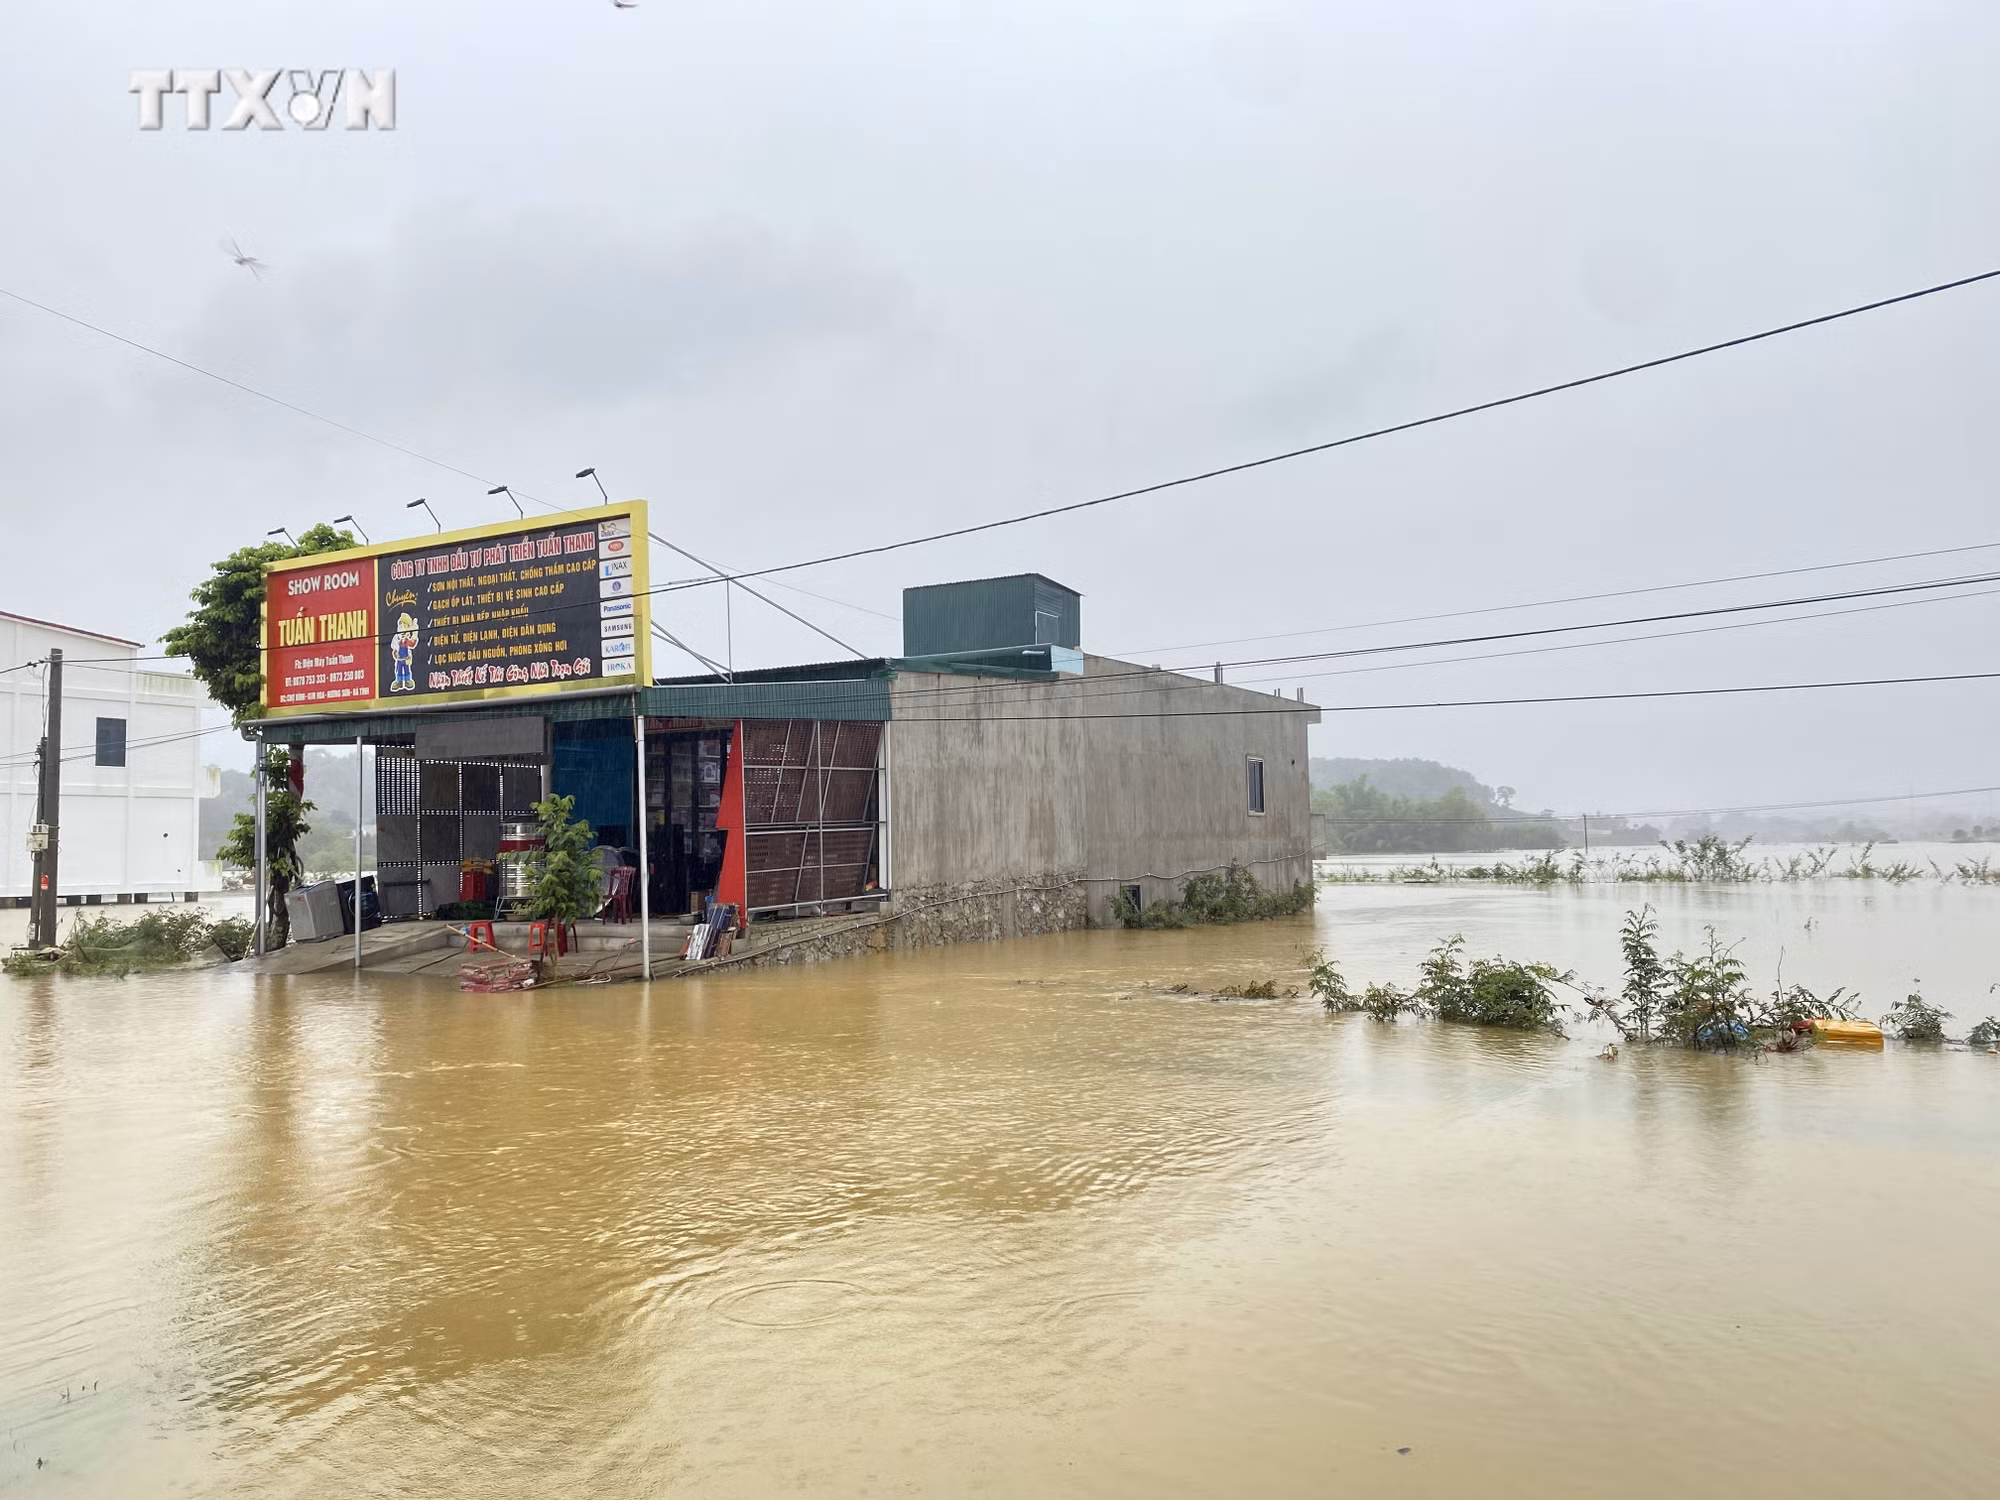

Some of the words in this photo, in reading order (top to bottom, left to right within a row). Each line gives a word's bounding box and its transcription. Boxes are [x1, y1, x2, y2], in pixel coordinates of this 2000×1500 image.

[391, 560, 413, 580] CÔNG
[415, 558, 425, 576] TY
[427, 555, 449, 575] TNHH
[450, 547, 468, 571] ĐẦU
[469, 548, 482, 568] TƯ
[508, 536, 535, 562] TRIỂN
[536, 532, 561, 558] TUẤN
[563, 532, 595, 554] THANH
[288, 576, 321, 596] SHOW
[324, 570, 359, 590] ROOM
[432, 581, 445, 592] SƠN
[446, 577, 458, 592] NỘI
[477, 572, 498, 587] NGOẠI
[520, 565, 543, 580] CHỐNG
[566, 563, 580, 575] CAO
[582, 556, 597, 571] CẤP
[432, 598, 449, 611] GẠCH
[450, 594, 460, 608] ỐP
[461, 595, 475, 607] LÁT,
[477, 590, 495, 605] THIẾT
[496, 590, 503, 604] BỊ
[505, 587, 514, 602] VỆ
[516, 587, 533, 599] SINH
[534, 586, 549, 597] CAO
[550, 580, 565, 595] CẤP
[604, 602, 632, 613] Panasonic
[278, 607, 315, 647] TUẤN
[319, 609, 367, 642] THANH
[480, 629, 500, 642] LẠNH,
[520, 623, 535, 636] DÂN
[537, 622, 556, 636] DỤNG
[604, 622, 632, 632] SAMSUNG
[338, 653, 354, 664] Thanh
[434, 654, 447, 666] LỌC
[448, 649, 466, 663] NƯỚC
[534, 640, 553, 654] XÔNG
[555, 640, 568, 651] HƠI
[316, 673, 326, 684] 333
[450, 665, 474, 687] Thiết
[506, 664, 529, 683] Công
[530, 661, 549, 680] Nhà
[550, 659, 572, 679] Trọn
